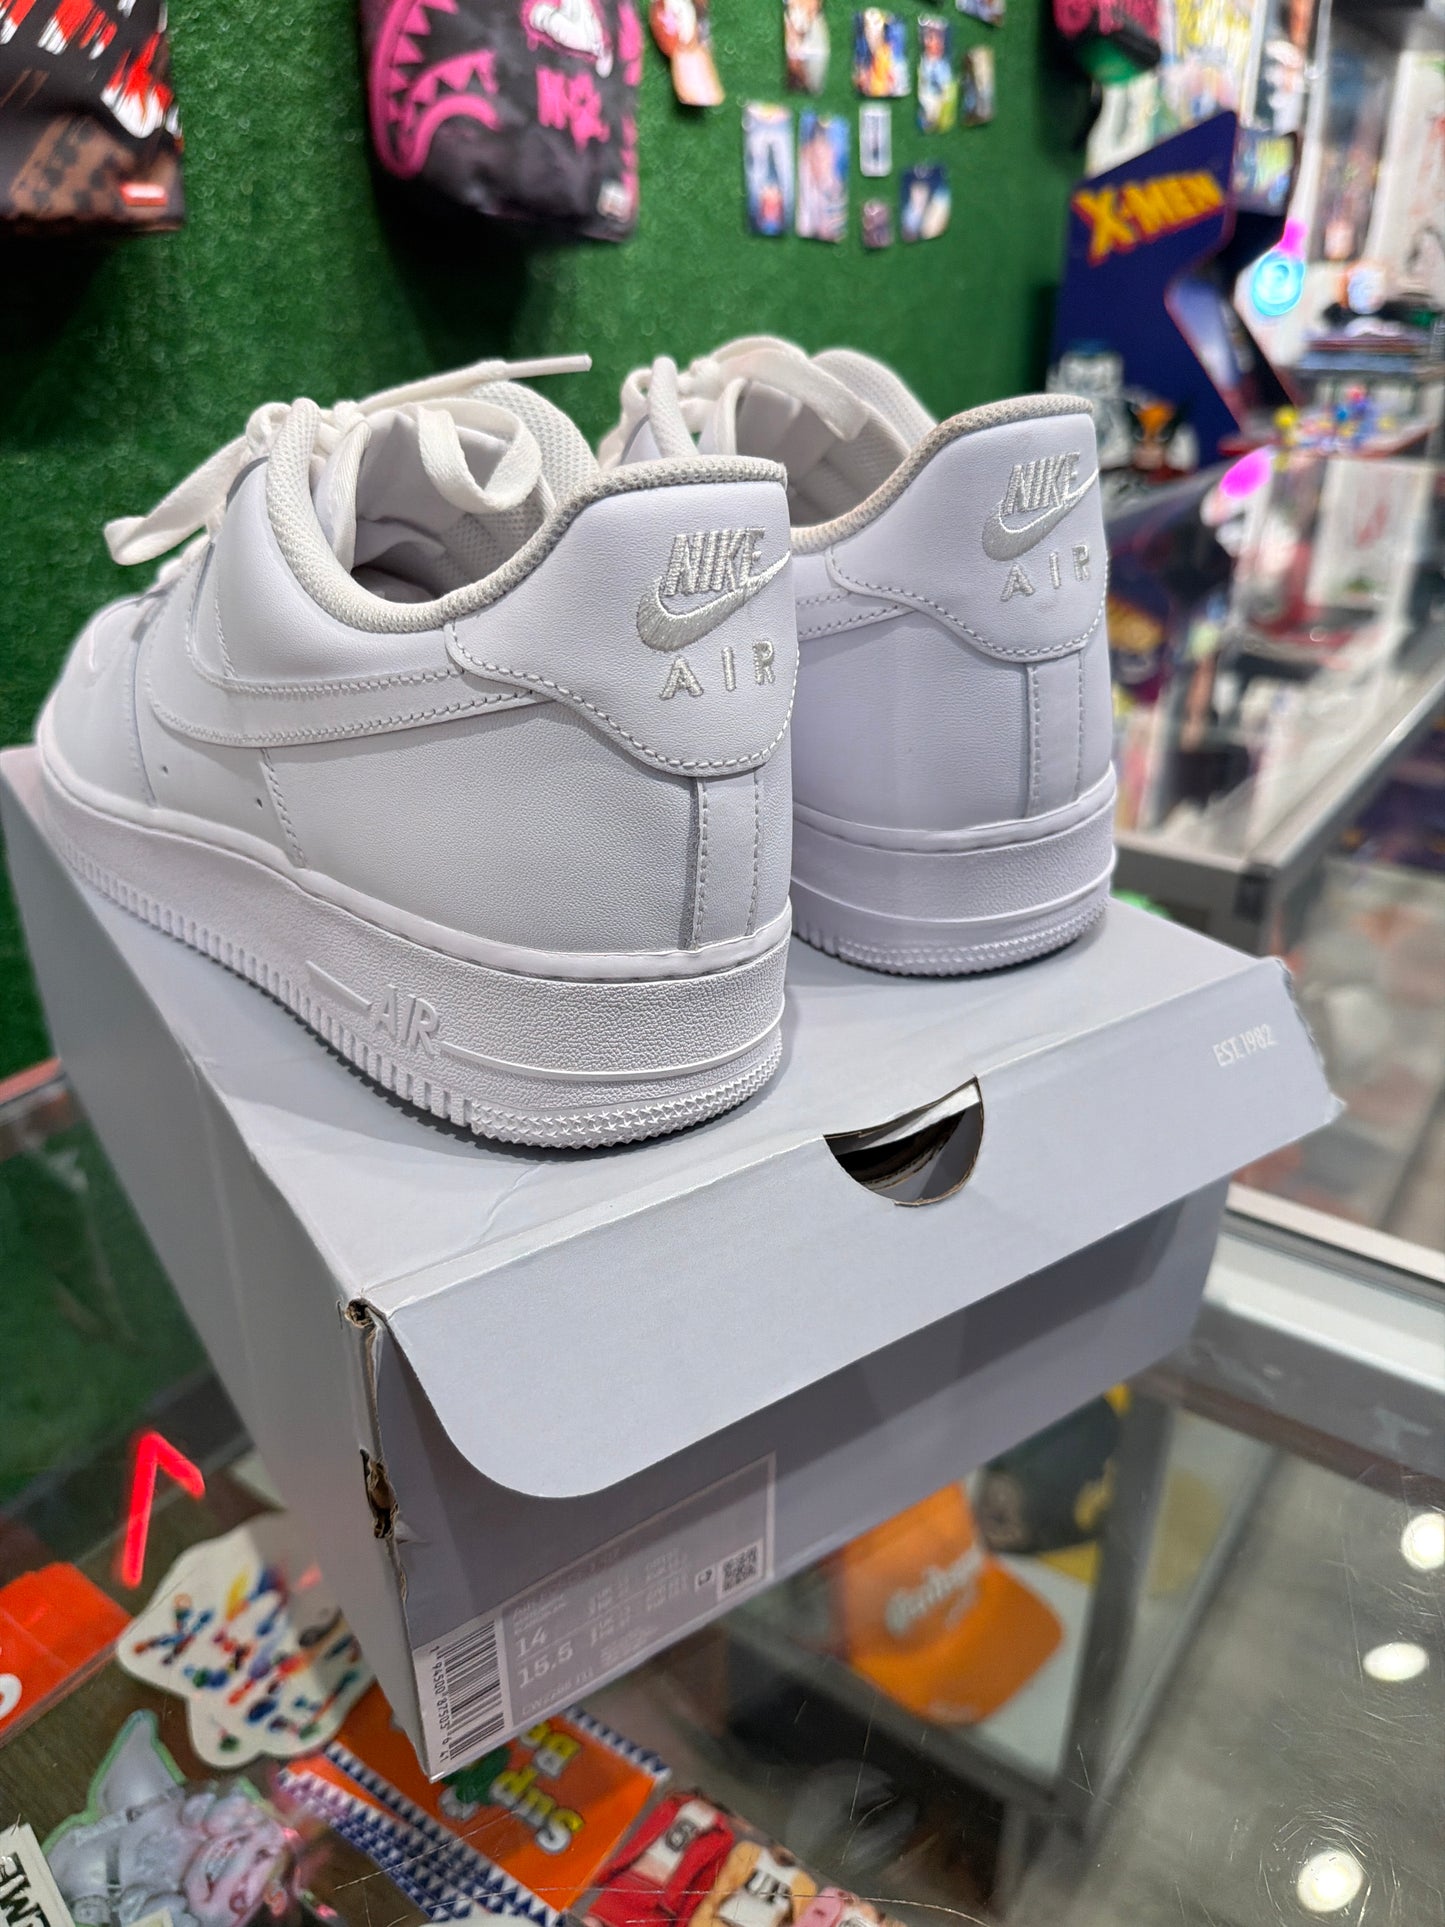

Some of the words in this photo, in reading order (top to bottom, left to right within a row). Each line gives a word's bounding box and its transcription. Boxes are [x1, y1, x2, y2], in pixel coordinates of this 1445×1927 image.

[1073, 171, 1223, 267] X-MEN
[1003, 452, 1080, 514] NIKE
[663, 526, 766, 597] NIKE
[1001, 544, 1089, 602] AIR
[659, 639, 775, 700] AIR
[373, 984, 438, 1055] AIR
[1240, 1024, 1279, 1055] 1982
[517, 1626, 547, 1657] 14
[518, 1641, 574, 1688] 15.5
